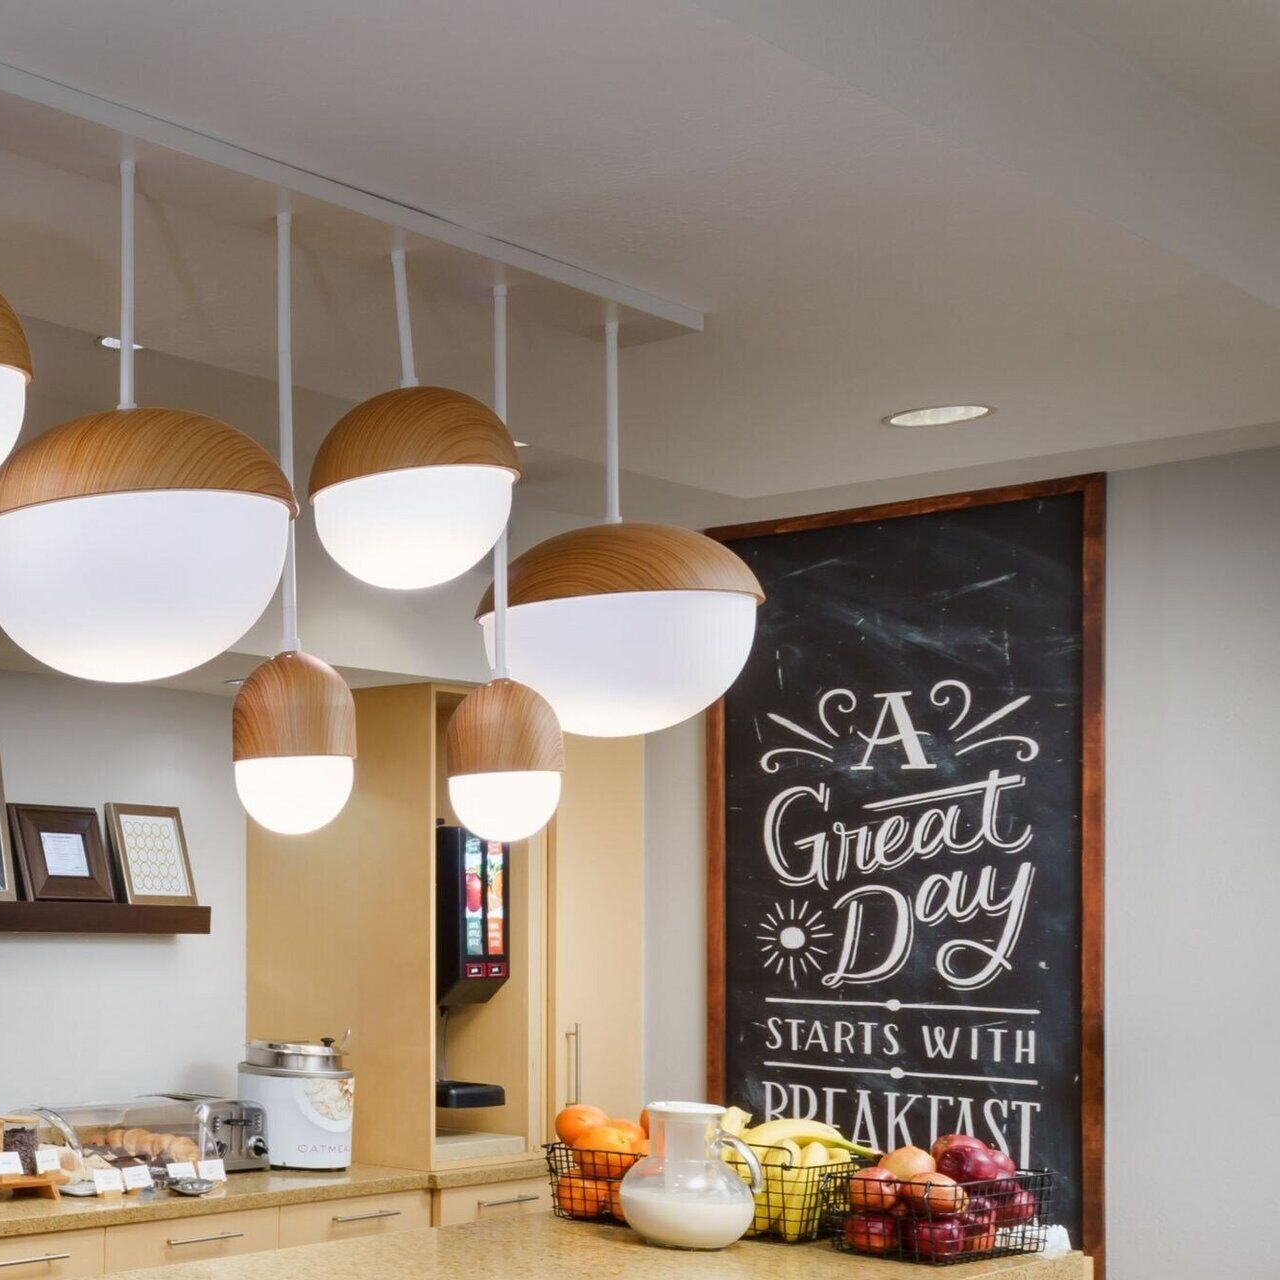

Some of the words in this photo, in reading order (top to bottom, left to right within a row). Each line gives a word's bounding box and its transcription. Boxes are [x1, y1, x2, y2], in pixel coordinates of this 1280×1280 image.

[851, 690, 937, 771] A
[763, 769, 1035, 890] Great
[821, 861, 1036, 991] Day
[764, 1017, 900, 1055] STARTS
[922, 1025, 1037, 1065] WITH
[297, 1144, 351, 1153] OATMEA
